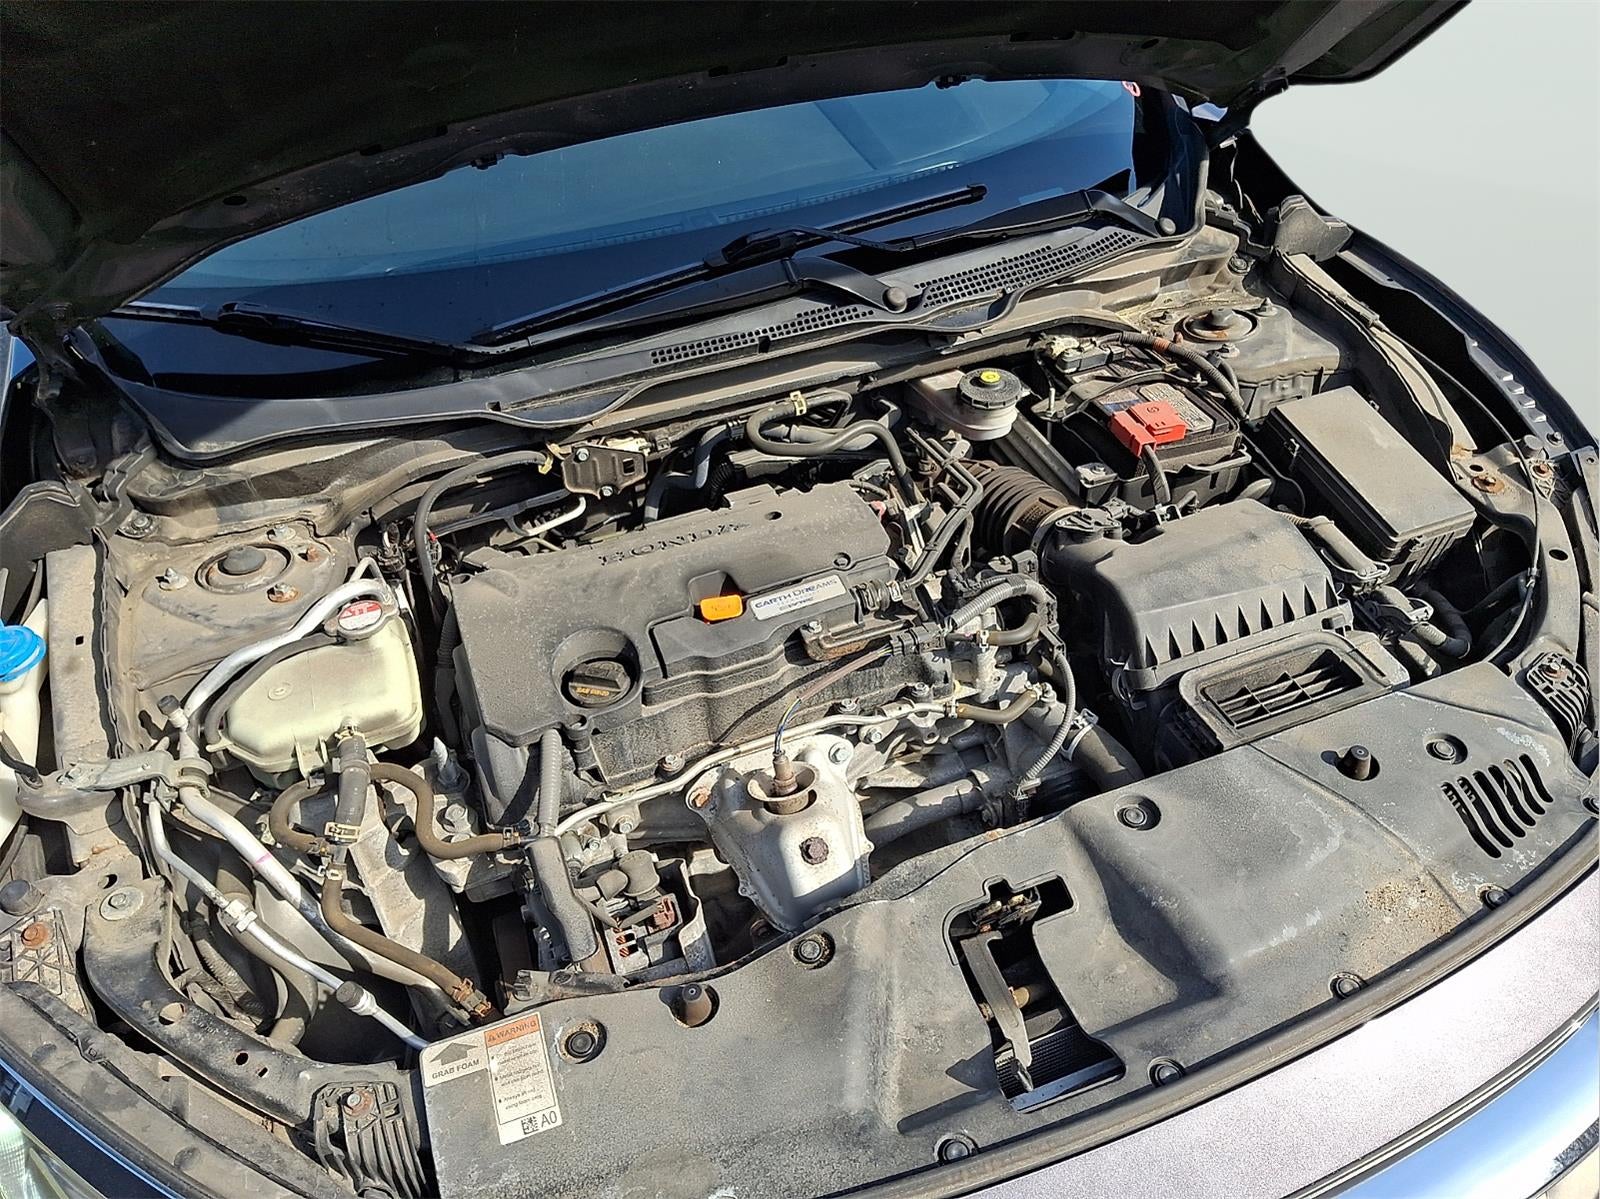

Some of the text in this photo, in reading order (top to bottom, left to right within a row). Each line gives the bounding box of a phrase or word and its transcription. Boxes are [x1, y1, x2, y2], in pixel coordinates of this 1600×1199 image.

[598, 523, 750, 566] HONDA
[755, 591, 792, 610] EARTH
[792, 578, 838, 600] DREAMS
[496, 1020, 537, 1039] WARNING
[431, 1058, 480, 1079] GRAB FOAM
[541, 1110, 558, 1129] A0
